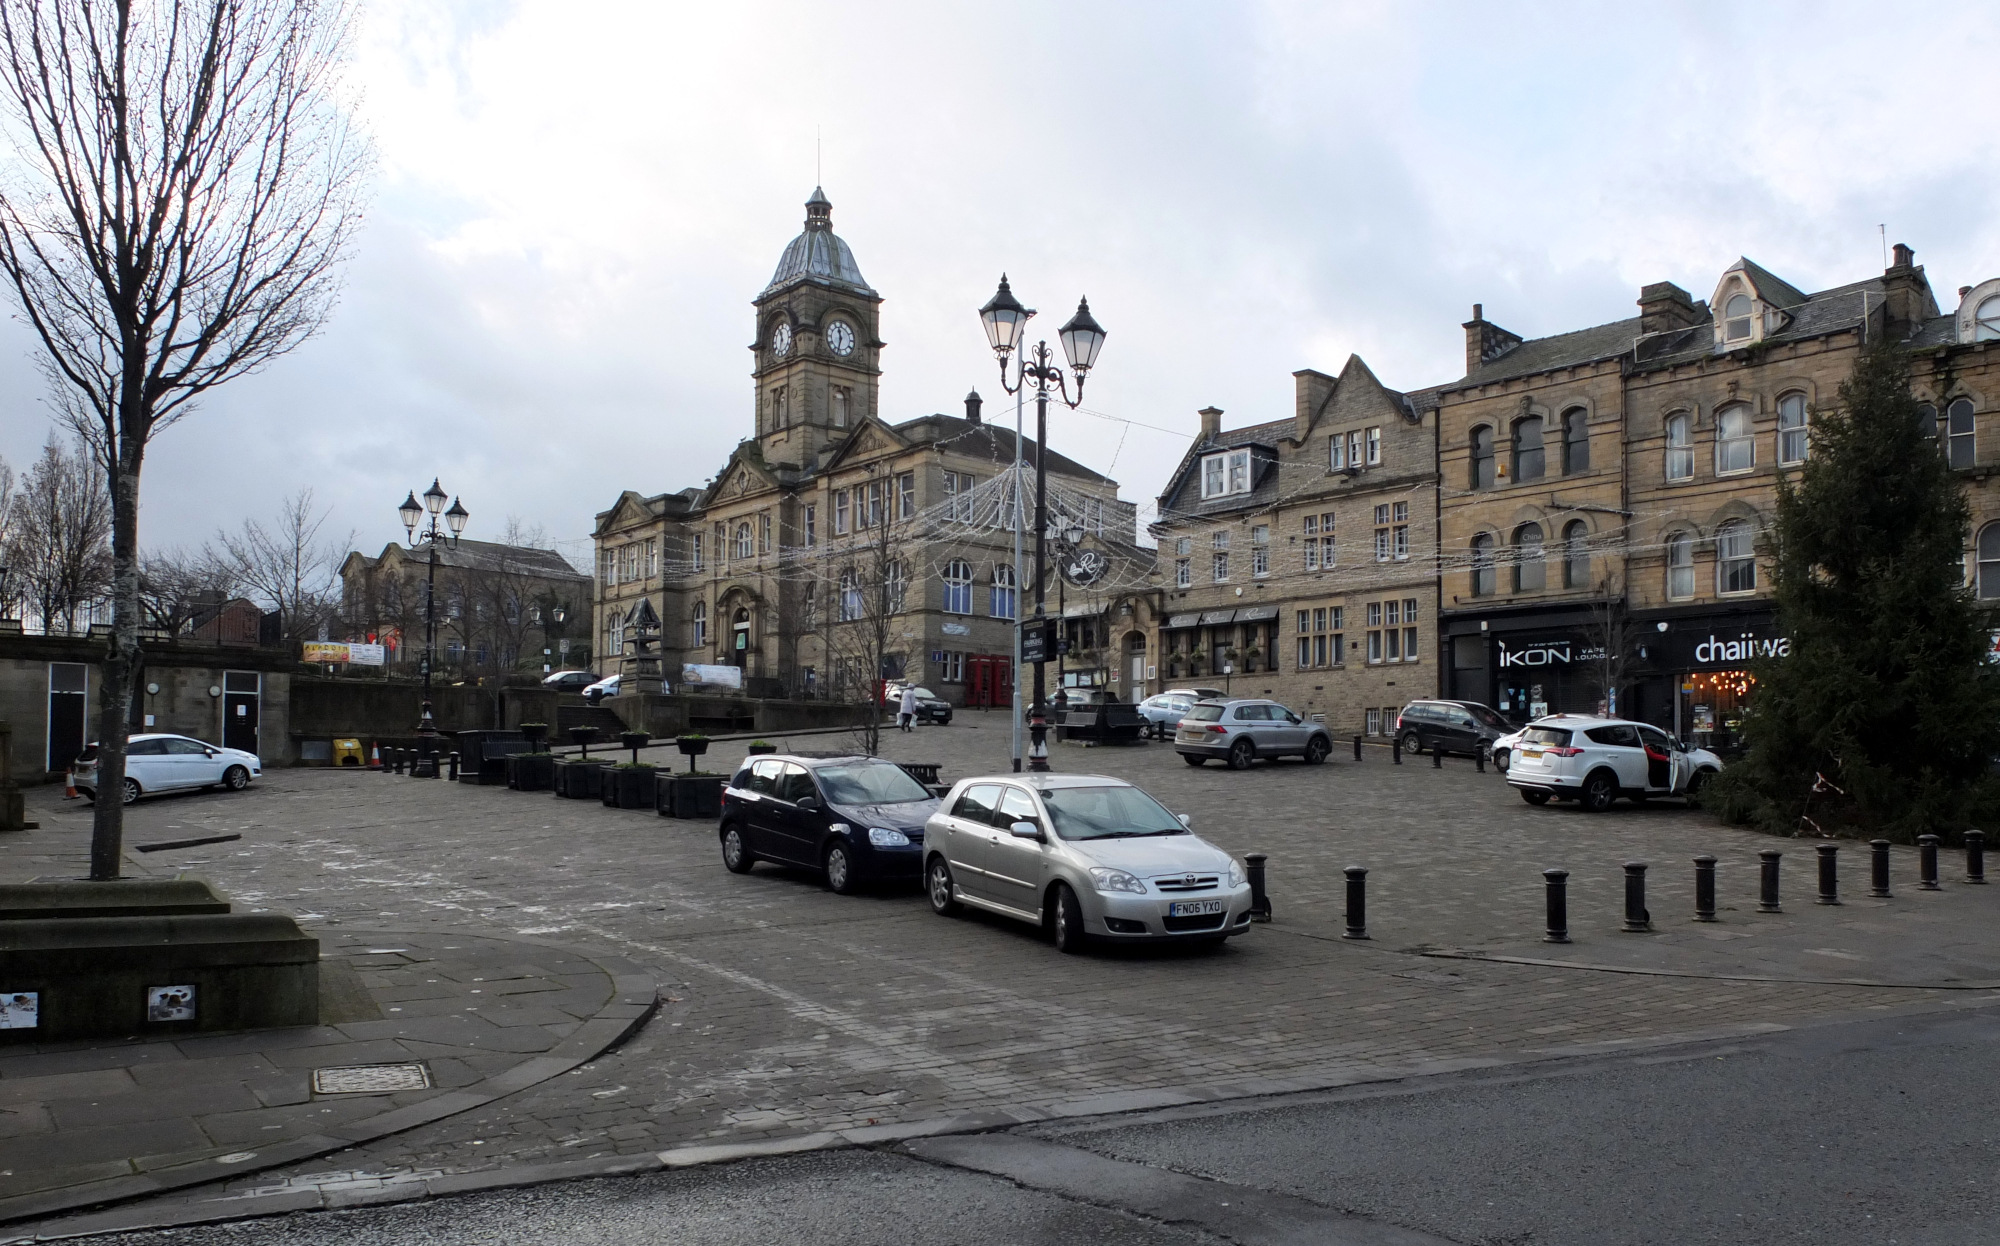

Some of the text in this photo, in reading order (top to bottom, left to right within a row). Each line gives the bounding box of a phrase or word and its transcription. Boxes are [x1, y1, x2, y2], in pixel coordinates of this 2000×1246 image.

[1522, 533, 1542, 541] China
[1024, 638, 1042, 648] PARKING
[1695, 632, 1794, 662] chaiiwa
[1176, 903, 1200, 914] FN06
